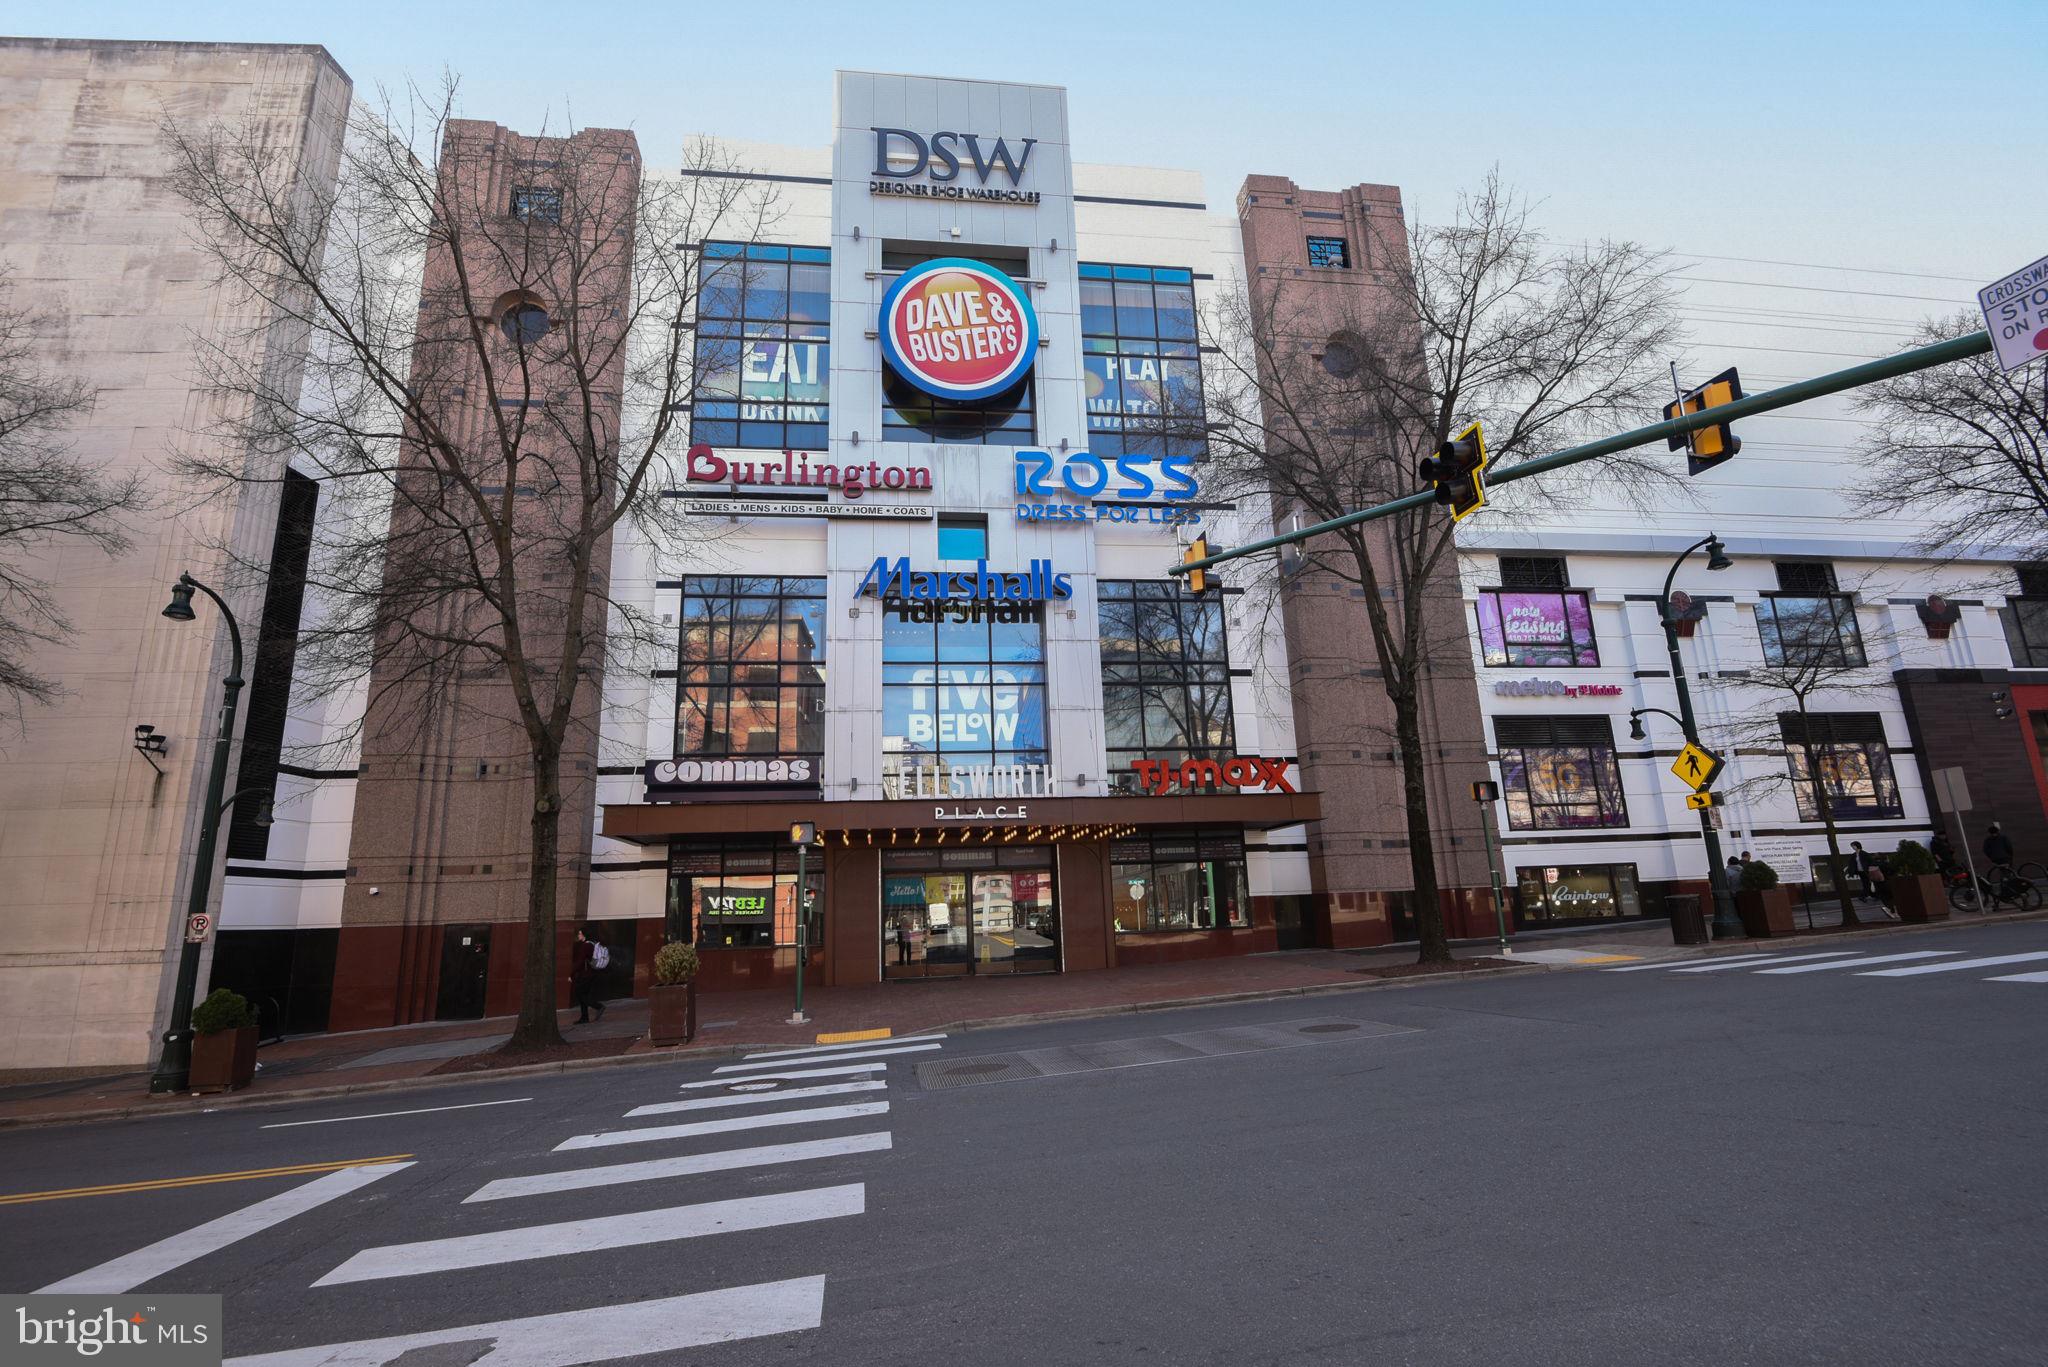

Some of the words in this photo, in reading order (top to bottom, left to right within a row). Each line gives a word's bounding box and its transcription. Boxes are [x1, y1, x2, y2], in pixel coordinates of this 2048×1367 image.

[870, 127, 1038, 187] DSW
[869, 181, 929, 196] DESIGNER
[931, 184, 964, 199] SHOE
[966, 187, 1041, 203] WAREHOUSE
[906, 291, 989, 332] DAVE
[986, 292, 1014, 323] &
[2002, 319, 2030, 340] ON
[909, 325, 1017, 362] BUSTER'S
[743, 333, 827, 385] EAT
[1106, 351, 1172, 381] PLAY
[742, 395, 821, 421] DRINK
[686, 443, 933, 499] Burlington
[1015, 451, 1199, 500] ROSS
[691, 502, 730, 512] LADIES
[741, 503, 771, 513] MENS
[781, 504, 806, 513] KIDS
[815, 505, 843, 514] BABY
[853, 506, 883, 515] HOME
[893, 507, 927, 516] COATS
[1017, 503, 1086, 521] DRESS
[1096, 505, 1139, 524] FOR
[1149, 507, 1201, 524] LESS
[853, 556, 1073, 601] Marshalls
[1512, 606, 1541, 618] now
[1505, 614, 1565, 641] leasing
[908, 669, 1019, 710] five
[1495, 677, 1565, 696] metro
[1564, 685, 1577, 698] by
[908, 713, 1019, 742] BELOW
[654, 760, 811, 783] commas
[900, 764, 1058, 799] ELLSWORTH
[935, 806, 1027, 819] PLACE
[943, 852, 992, 861] commas
[890, 885, 920, 897] Hello!
[1552, 885, 1610, 901] Rainbow
